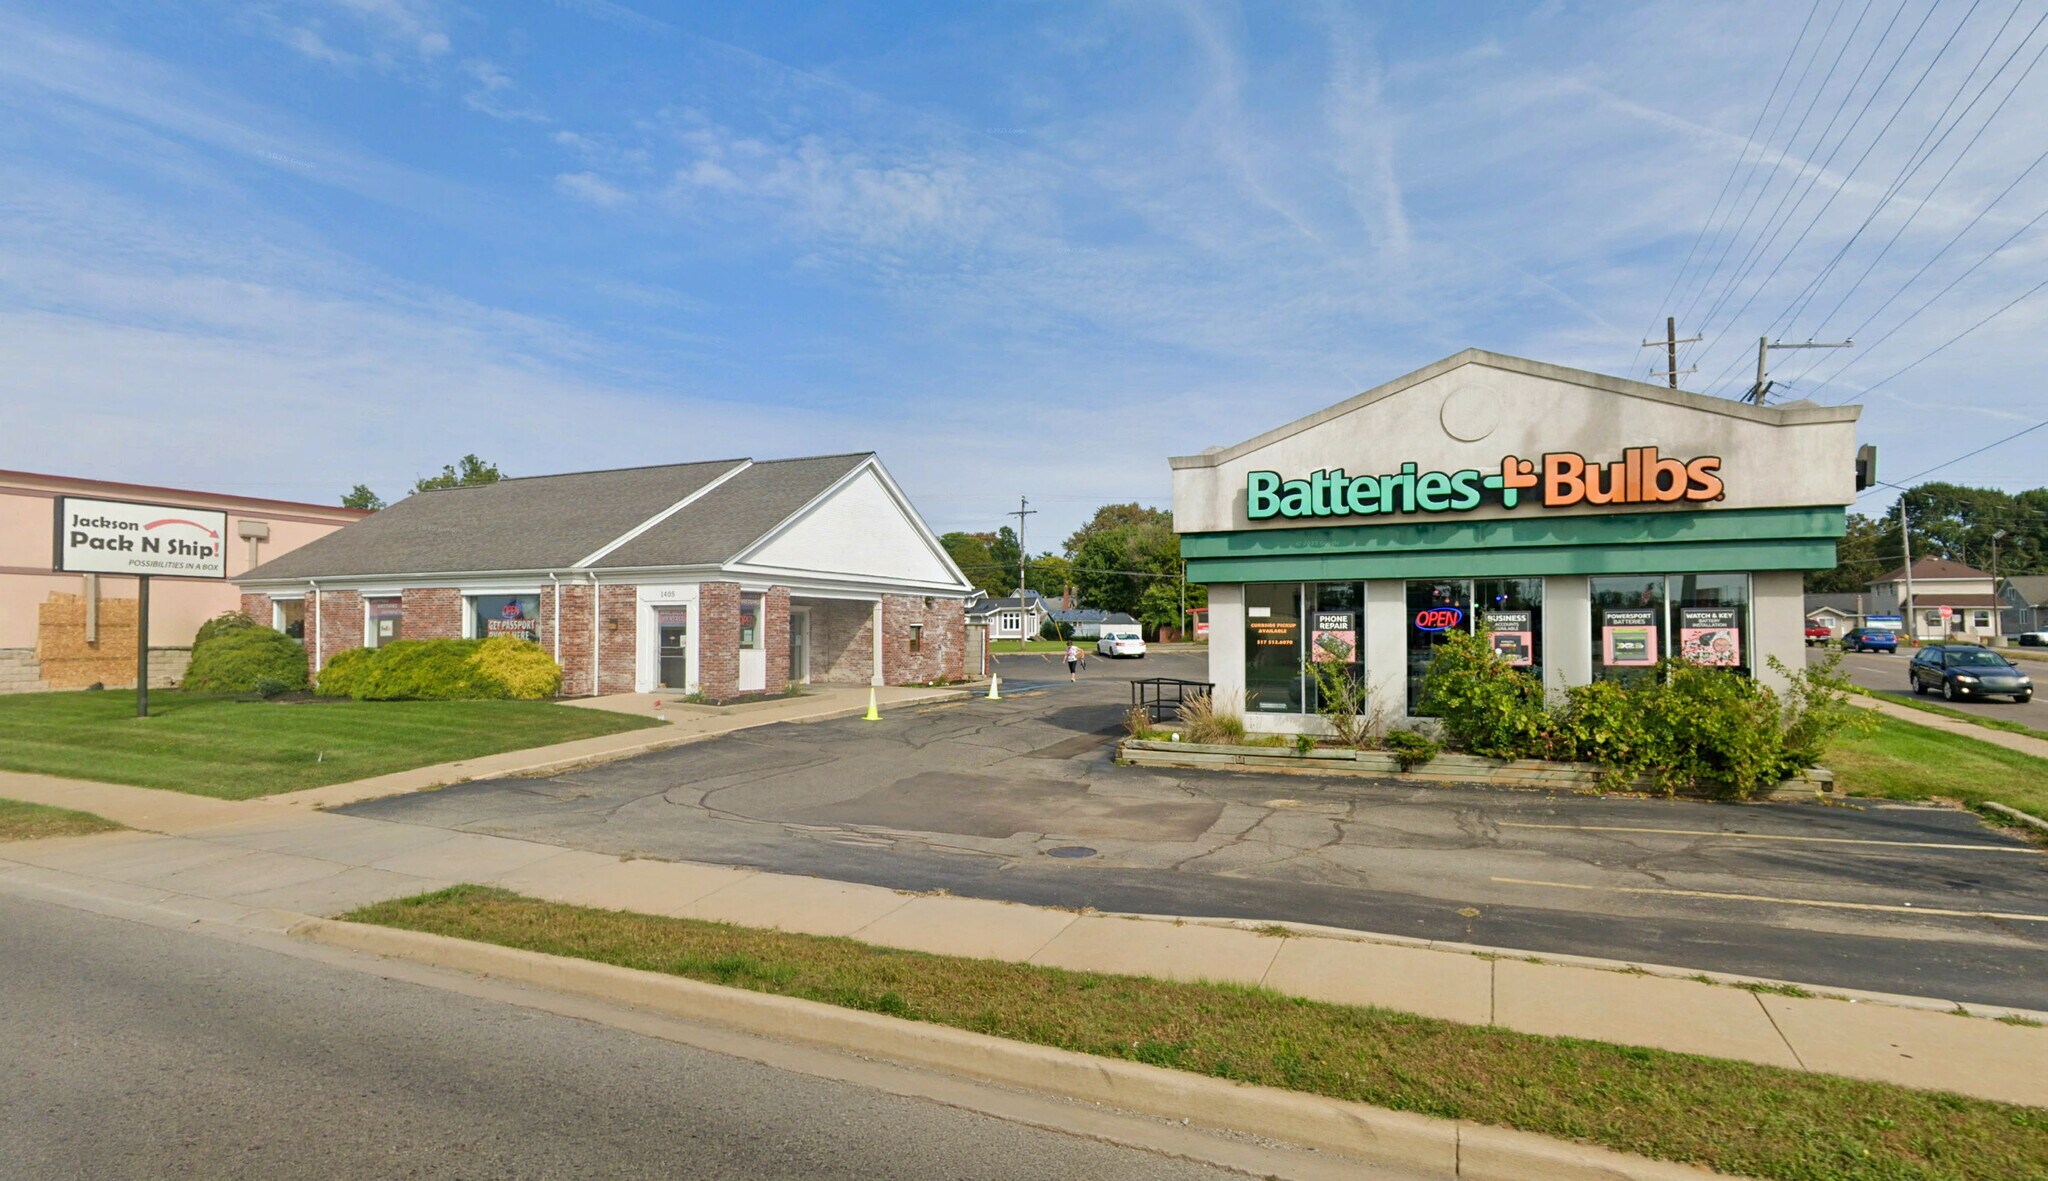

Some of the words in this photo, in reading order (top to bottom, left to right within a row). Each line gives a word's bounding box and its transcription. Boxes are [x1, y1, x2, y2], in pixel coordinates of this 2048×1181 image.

[1248, 462, 1480, 520] Batteries
[72, 514, 139, 531] Jackson
[70, 530, 134, 552] Pack
[141, 536, 160, 553] N
[167, 538, 219, 560] Ship!
[128, 559, 184, 569] POSSIBILITIES
[488, 620, 501, 630] GET
[502, 619, 536, 630] PASSPORT
[1416, 611, 1458, 627] OPEN
[1487, 614, 1527, 622] BUSINESS
